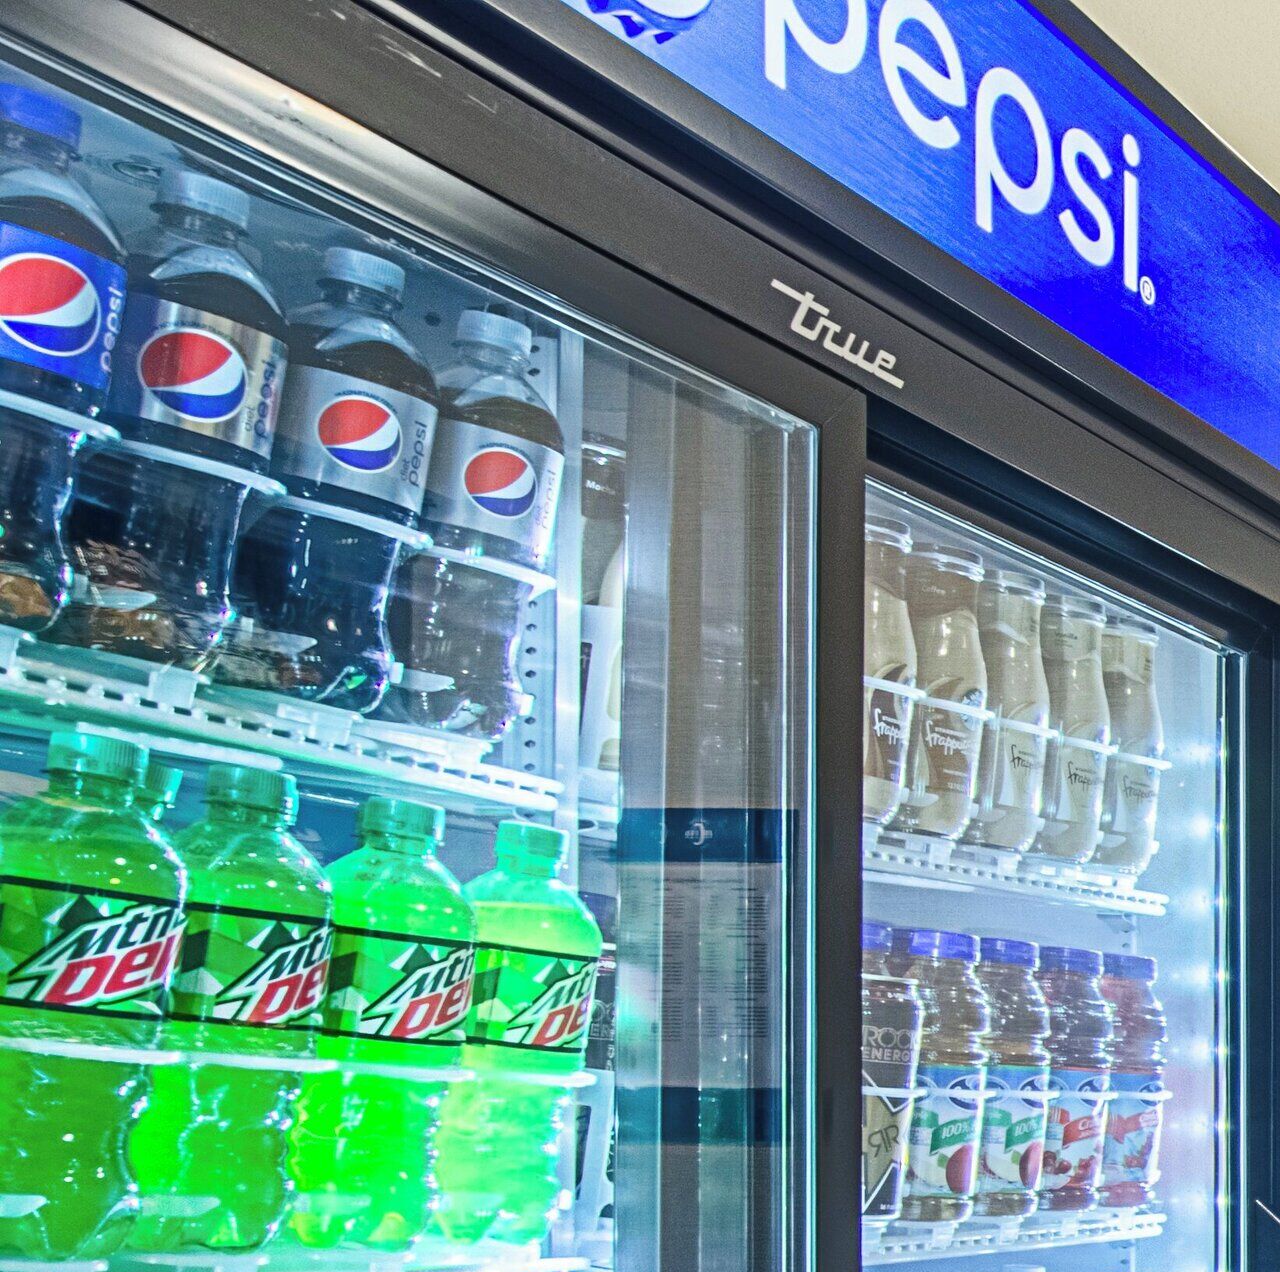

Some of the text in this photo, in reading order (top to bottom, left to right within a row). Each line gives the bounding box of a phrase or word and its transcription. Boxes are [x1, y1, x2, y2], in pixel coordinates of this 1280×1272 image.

[100, 284, 124, 374] pepsi
[407, 419, 428, 488] pepsi
[941, 1121, 970, 1139] 100%
